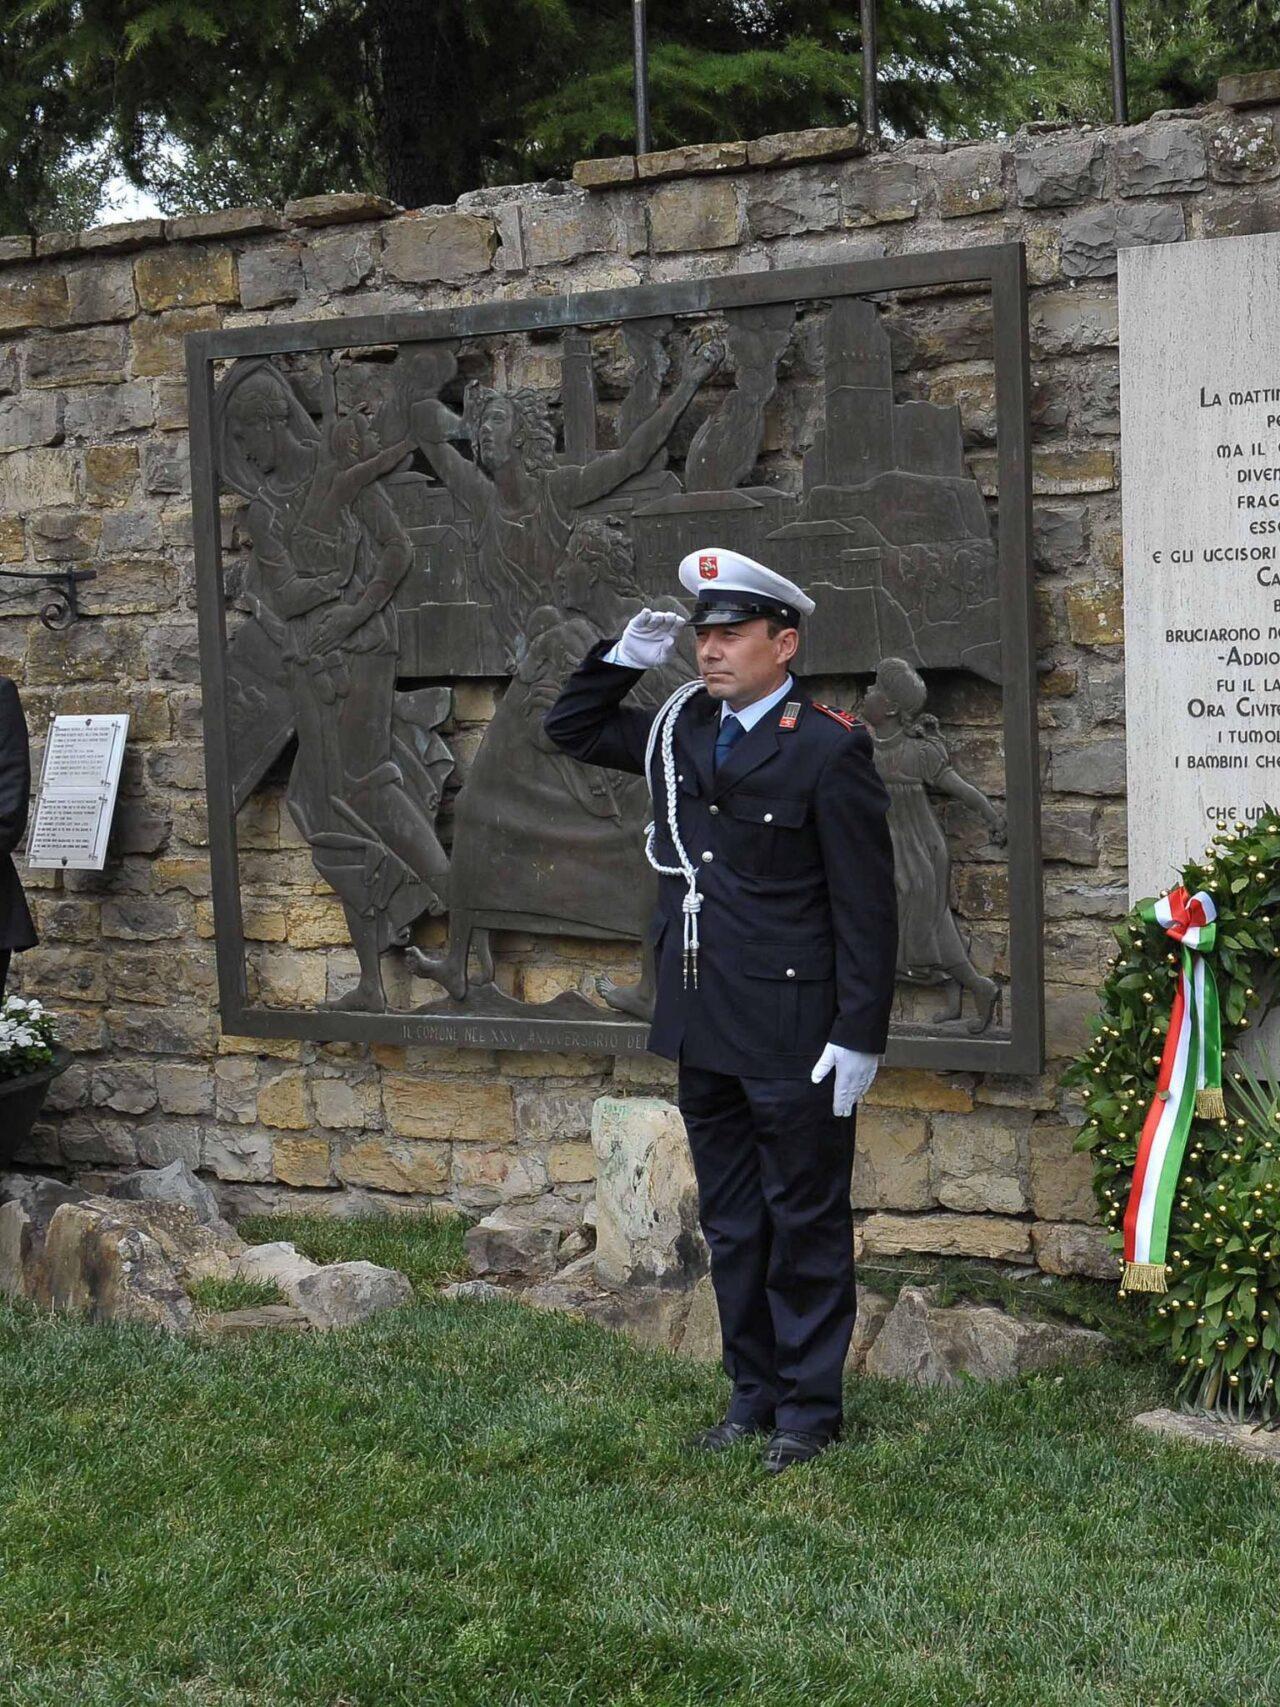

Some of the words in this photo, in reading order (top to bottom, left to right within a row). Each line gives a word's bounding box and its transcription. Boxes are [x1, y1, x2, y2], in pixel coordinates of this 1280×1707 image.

[1200, 386, 1222, 408] LA
[1216, 444, 1244, 459] MA
[1251, 442, 1266, 456] IL
[1152, 550, 1162, 564] E
[1170, 549, 1194, 564] GLI
[1203, 546, 1276, 563] UCCISORI
[1165, 627, 1261, 643] BRUCIARONO
[1216, 679, 1235, 693] FU
[1243, 678, 1256, 692] IL
[1187, 698, 1226, 718] ORA
[1218, 731, 1222, 743] I
[1175, 756, 1179, 769] I
[1187, 755, 1248, 769] BAMBINI
[1206, 806, 1237, 820] CHE
